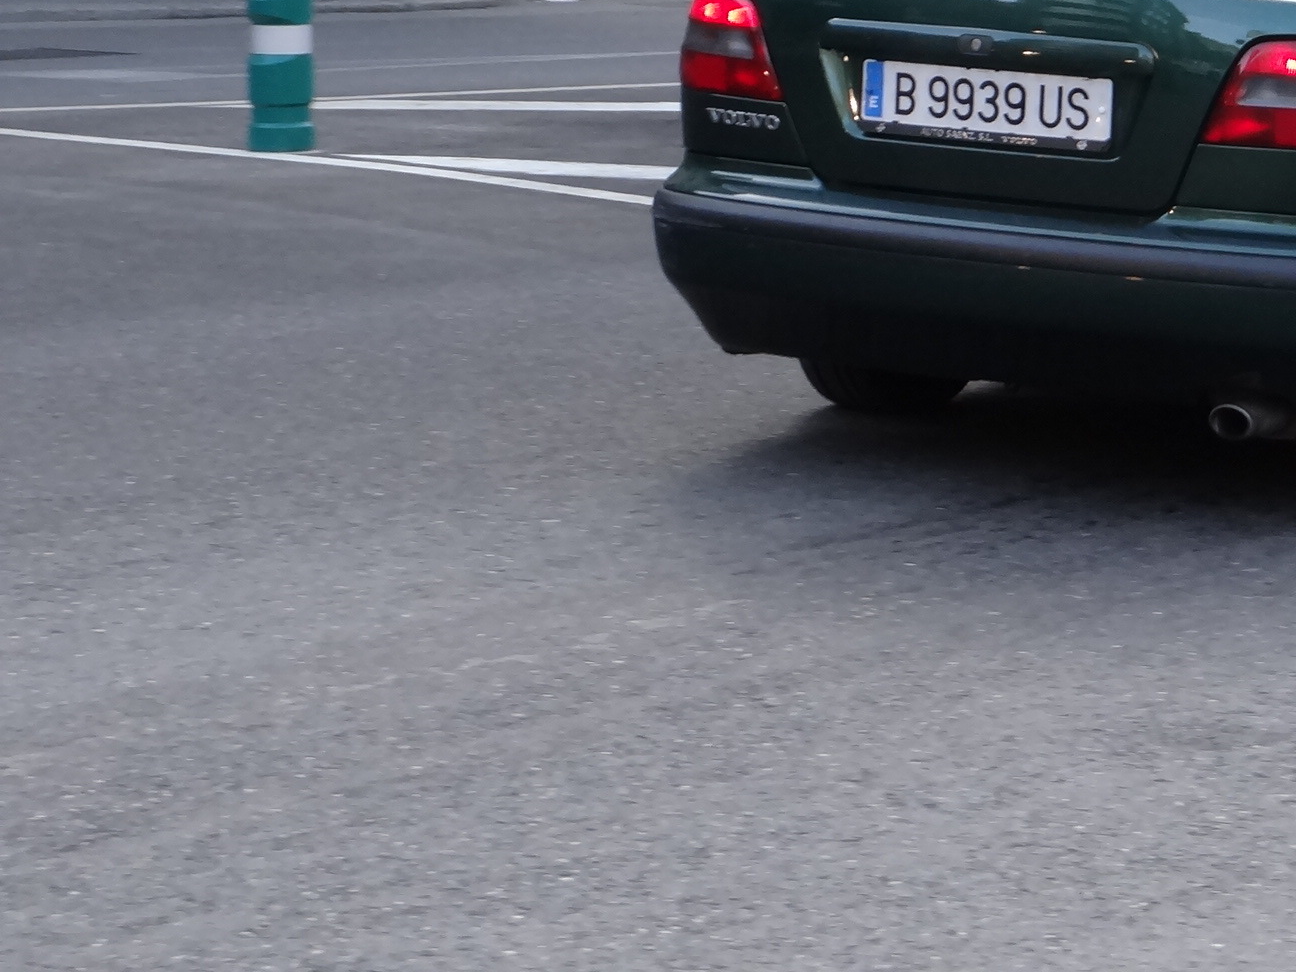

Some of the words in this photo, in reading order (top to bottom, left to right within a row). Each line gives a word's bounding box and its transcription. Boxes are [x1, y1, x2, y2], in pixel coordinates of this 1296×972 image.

[868, 95, 880, 109] E
[895, 72, 916, 116] B
[927, 76, 1026, 126] 9939
[1038, 84, 1090, 131] US
[705, 107, 781, 131] VOLVO
